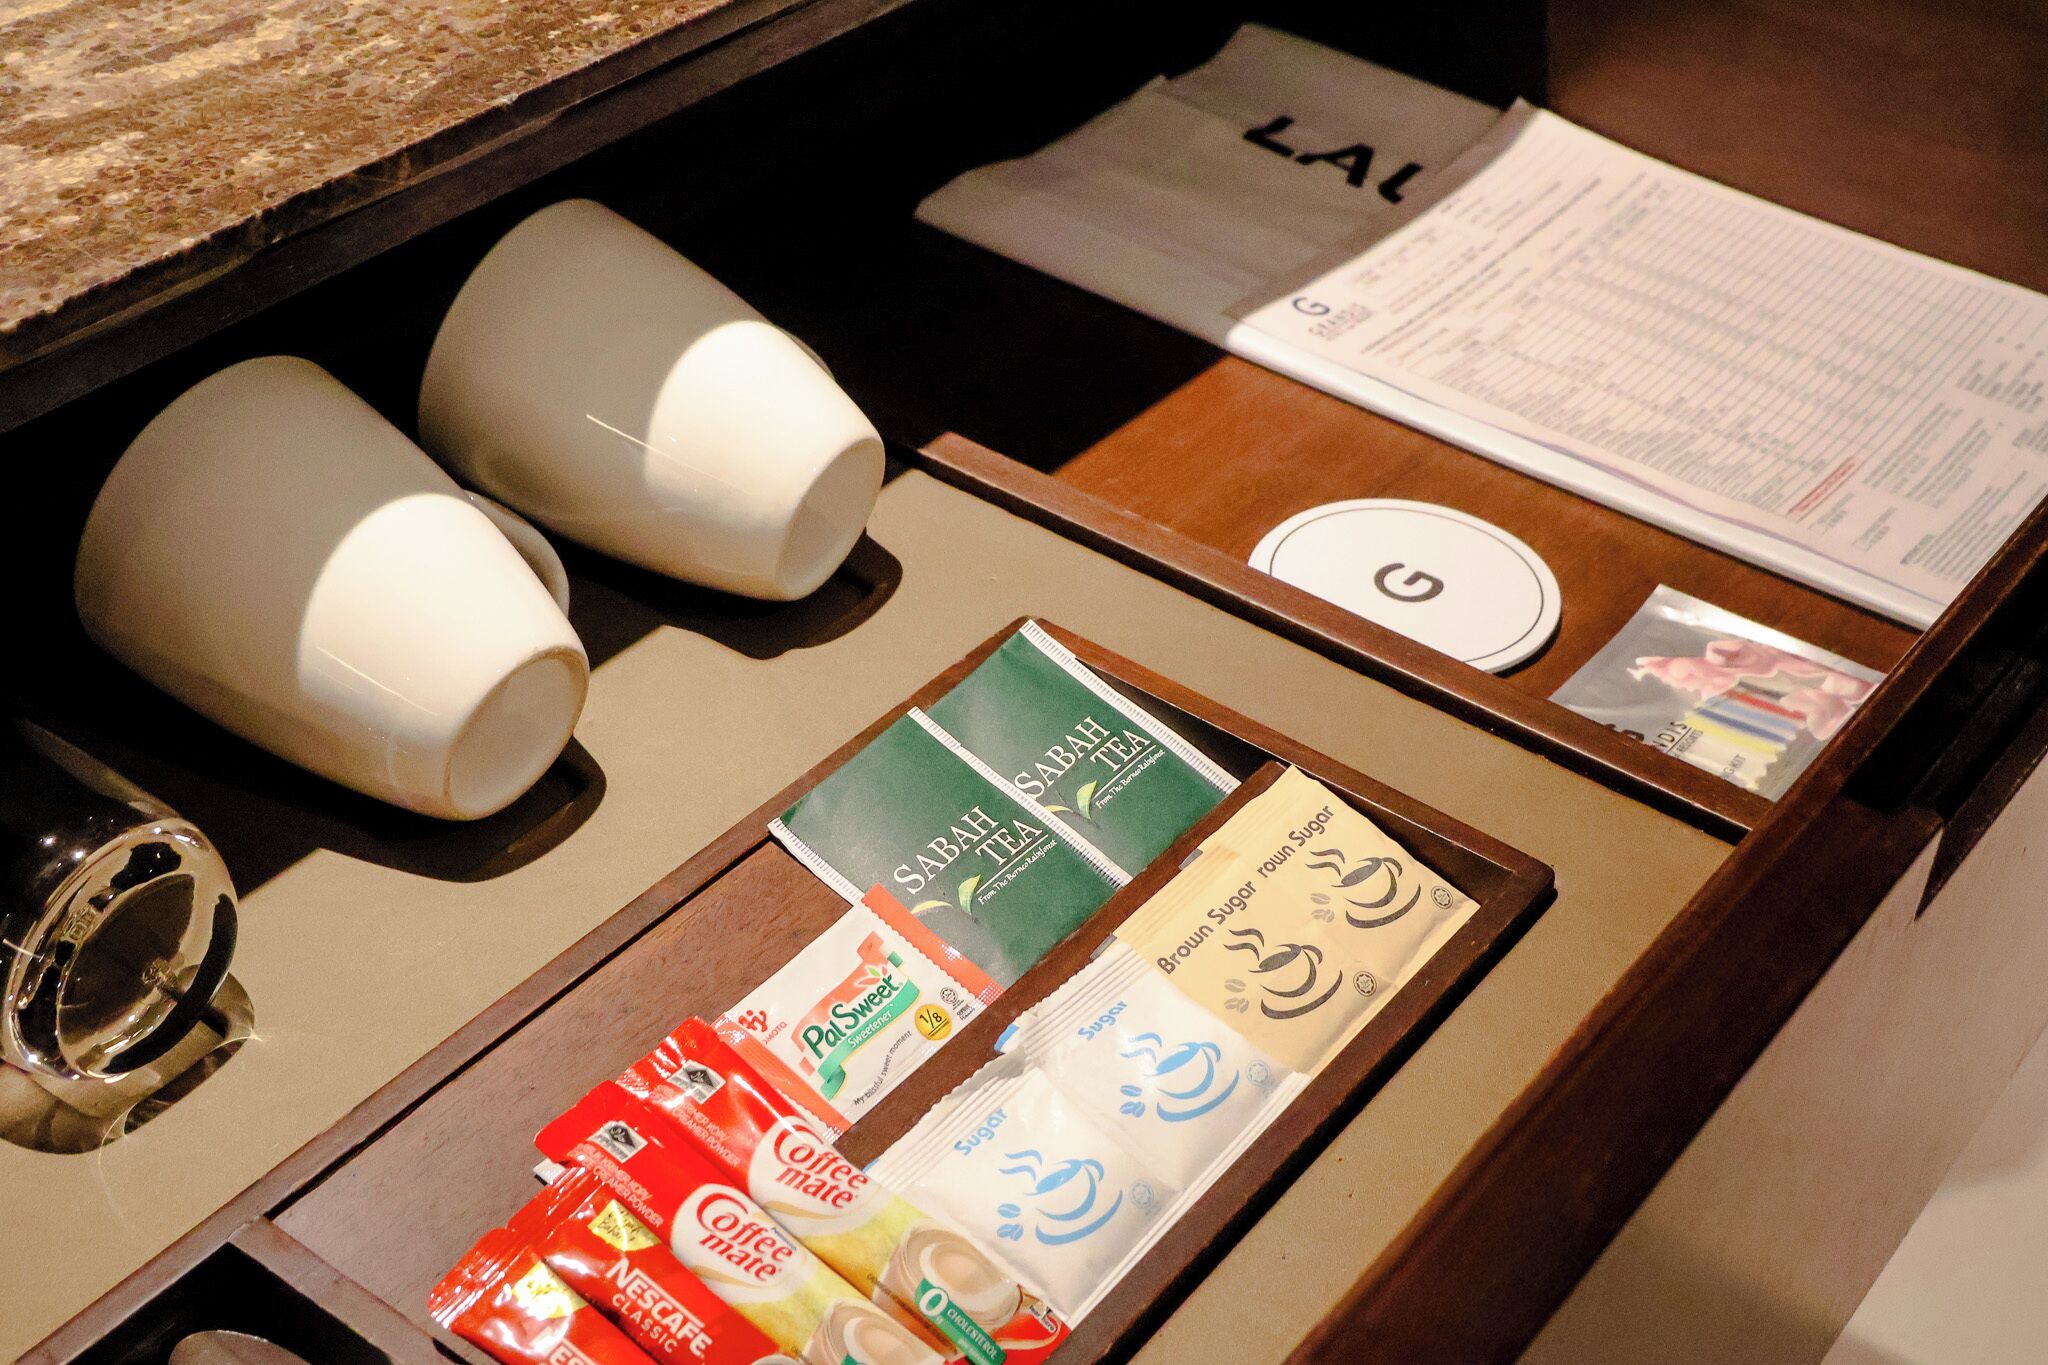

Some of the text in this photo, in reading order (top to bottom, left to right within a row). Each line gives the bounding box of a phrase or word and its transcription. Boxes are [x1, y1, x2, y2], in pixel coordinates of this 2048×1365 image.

[1292, 297, 1330, 316] G
[1373, 562, 1444, 602] G
[1014, 716, 1151, 800] SABAH TEA
[1095, 794, 1113, 808] From
[1108, 784, 1123, 795] The
[1120, 768, 1142, 786] Borneo
[893, 805, 1042, 895] SABAH TEA
[1256, 804, 1335, 879] rown Sugar
[978, 838, 1057, 905] From The Borneo Rainforest
[1156, 879, 1258, 975] Brown Sugar
[847, 1007, 894, 1049] Sweetener
[919, 1008, 943, 1029] 1/8
[1077, 999, 1128, 1041] Sugar
[881, 1054, 892, 1077] sweet
[889, 1030, 913, 1056] moment
[953, 1107, 1009, 1156] Sugar
[774, 1122, 868, 1189] Coffee
[626, 1193, 664, 1228] POWDER
[776, 1168, 854, 1210] mate
[696, 1192, 793, 1263] Coffee
[699, 1234, 778, 1282] mate
[611, 1292, 678, 1353] CLASSIC
[919, 1286, 949, 1317] 0
